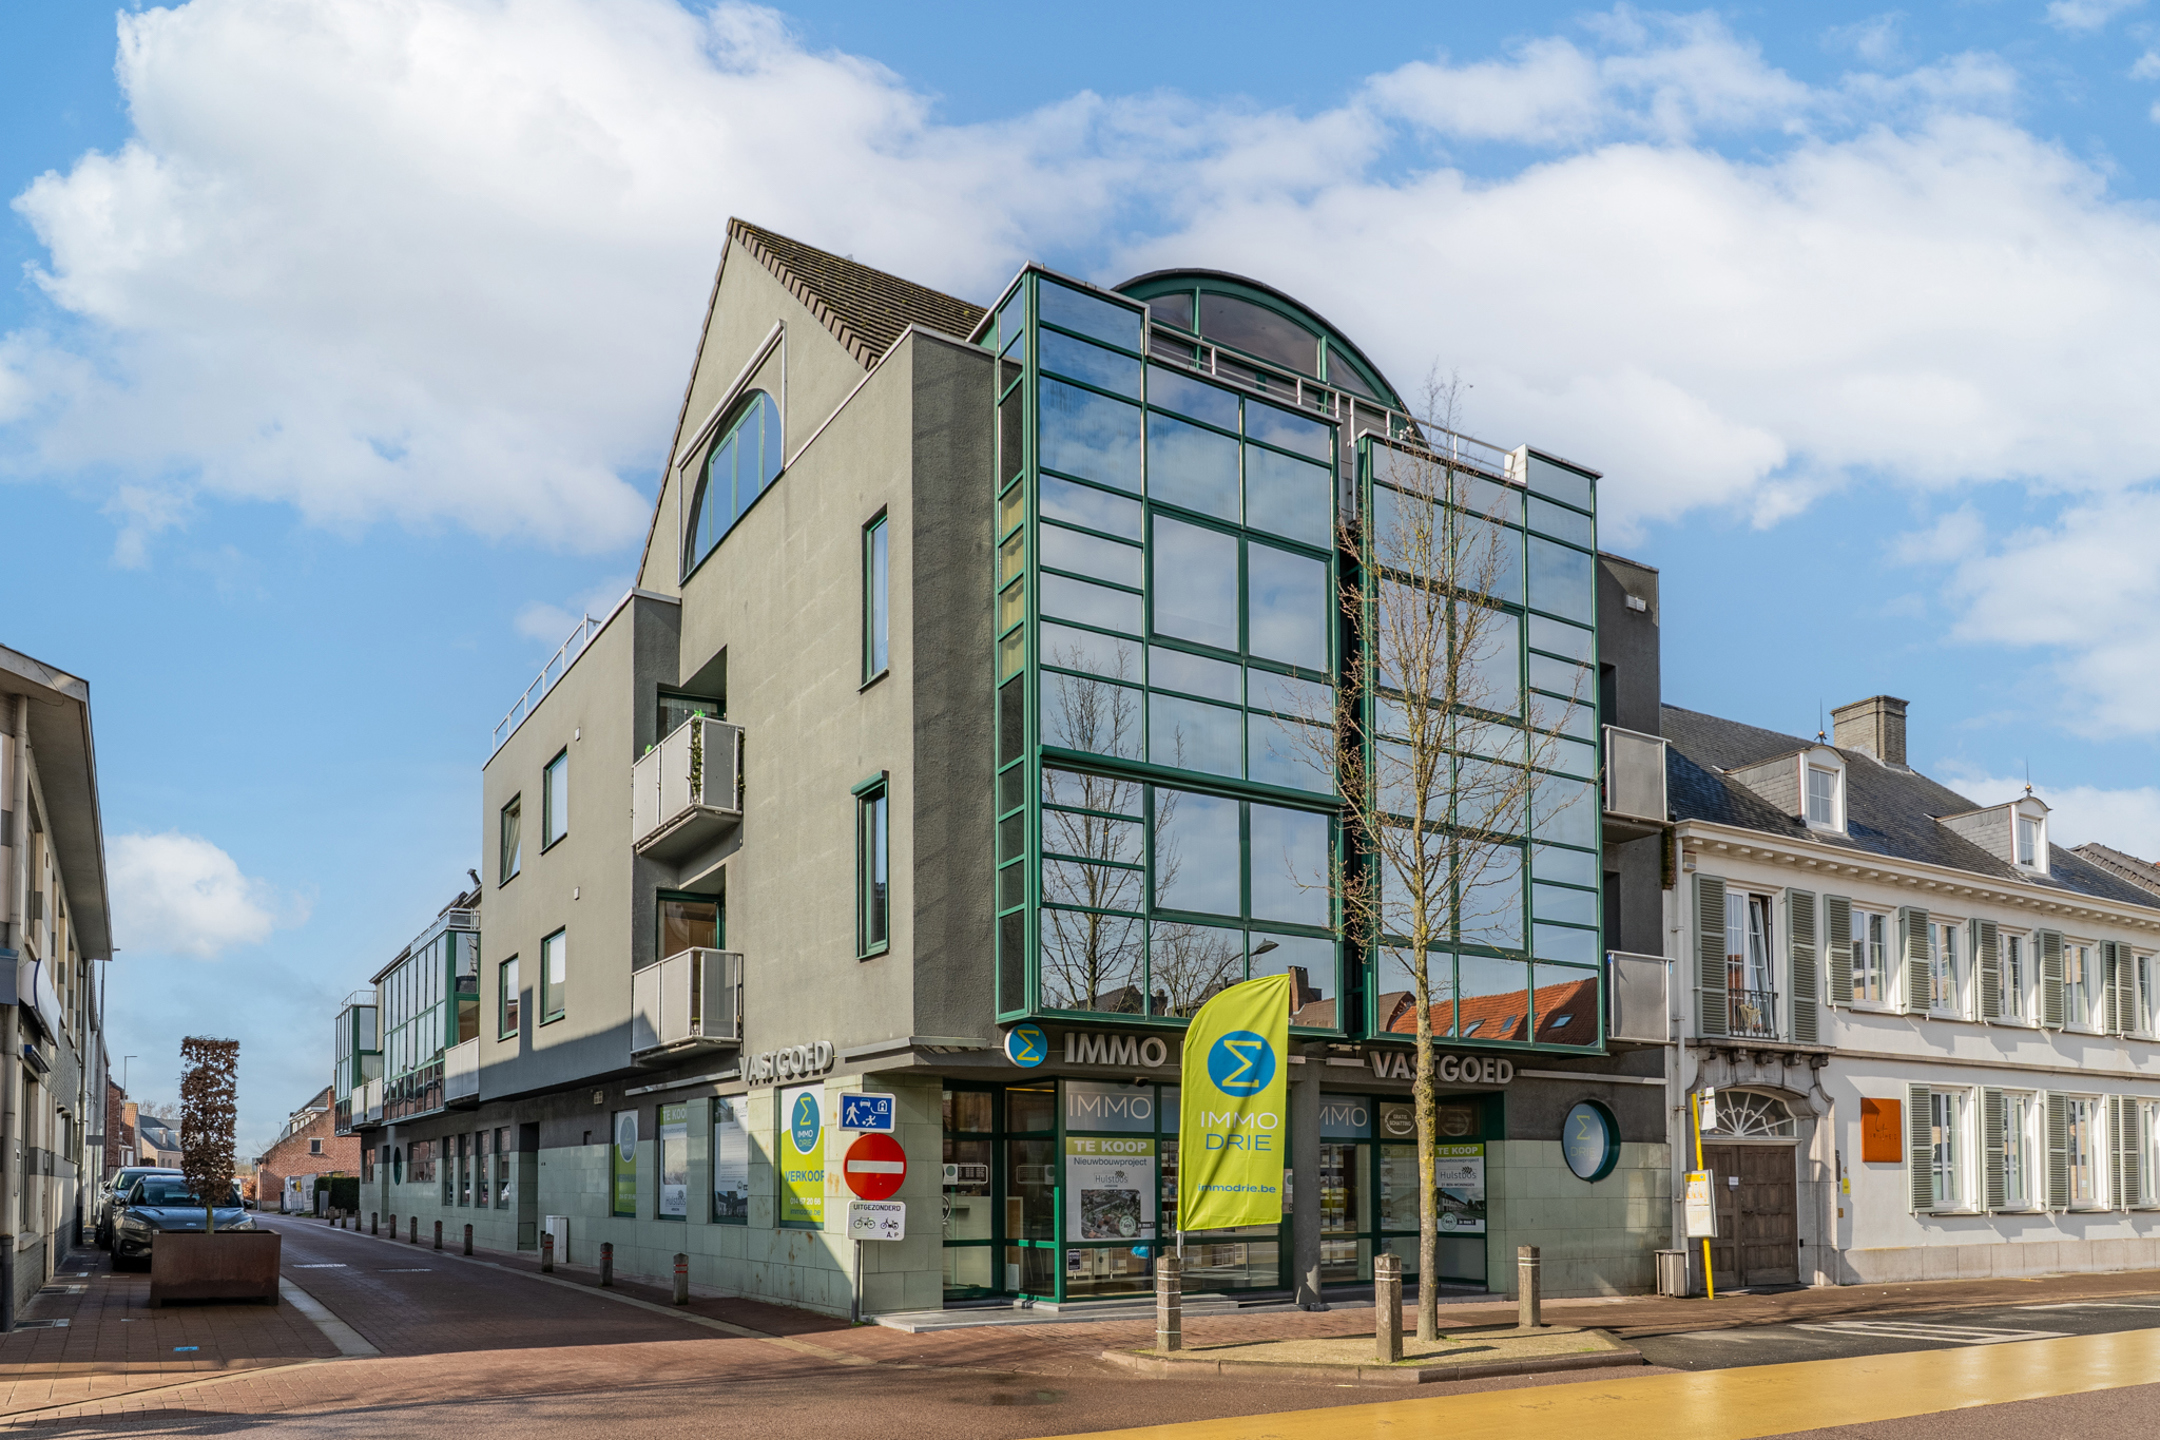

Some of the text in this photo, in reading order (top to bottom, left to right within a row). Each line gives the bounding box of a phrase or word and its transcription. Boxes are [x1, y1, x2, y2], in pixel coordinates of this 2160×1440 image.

[1064, 1033, 1167, 1067] IMMO
[738, 1041, 834, 1083] VASTGOED
[1069, 1094, 1152, 1119] IMMO
[672, 1108, 687, 1120] KOO
[1201, 1111, 1278, 1129] IMMO
[1319, 1106, 1367, 1127] MMO
[797, 1130, 813, 1138] IMMO
[798, 1139, 812, 1147] DRIE
[1074, 1140, 1147, 1153] TE KOOP
[1206, 1133, 1272, 1151] DRIE
[1437, 1146, 1478, 1155] TE KOOP
[1570, 1146, 1596, 1157] DRIE
[1073, 1157, 1147, 1168] Nieuwbouwproject
[1198, 1183, 1276, 1194] immodrie.be
